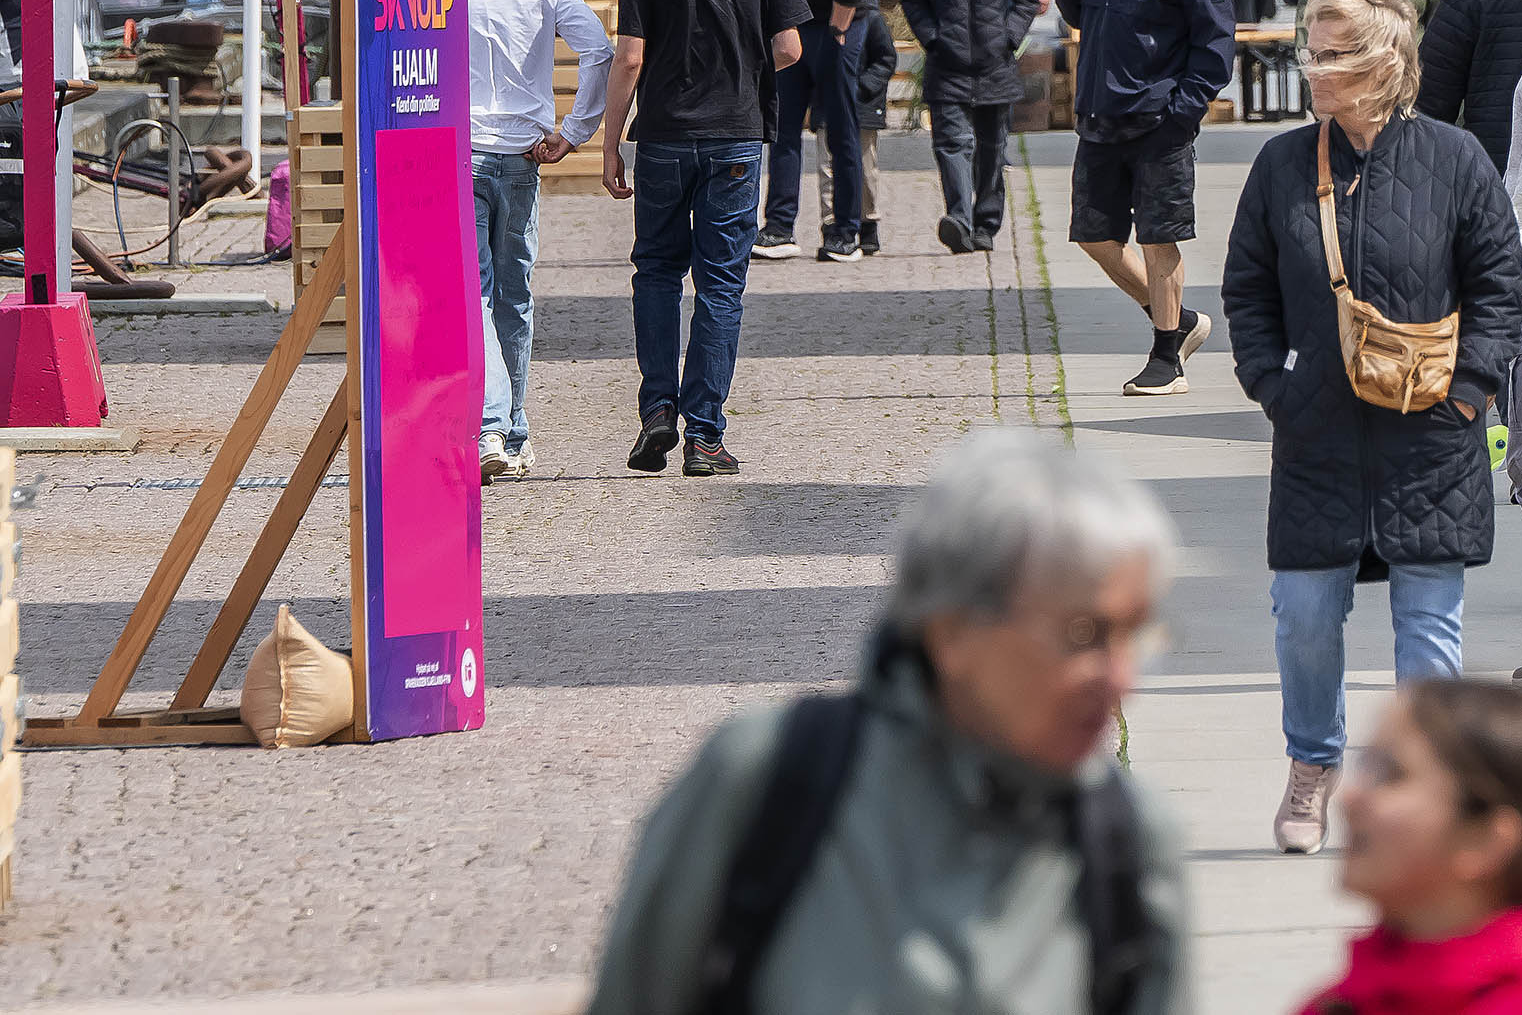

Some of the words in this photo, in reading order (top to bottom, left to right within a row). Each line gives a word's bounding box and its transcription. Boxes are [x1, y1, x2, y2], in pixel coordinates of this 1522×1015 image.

[392, 48, 438, 87] HJALM
[396, 95, 410, 114] Kend
[410, 95, 419, 113] din
[419, 93, 440, 117] politiker
